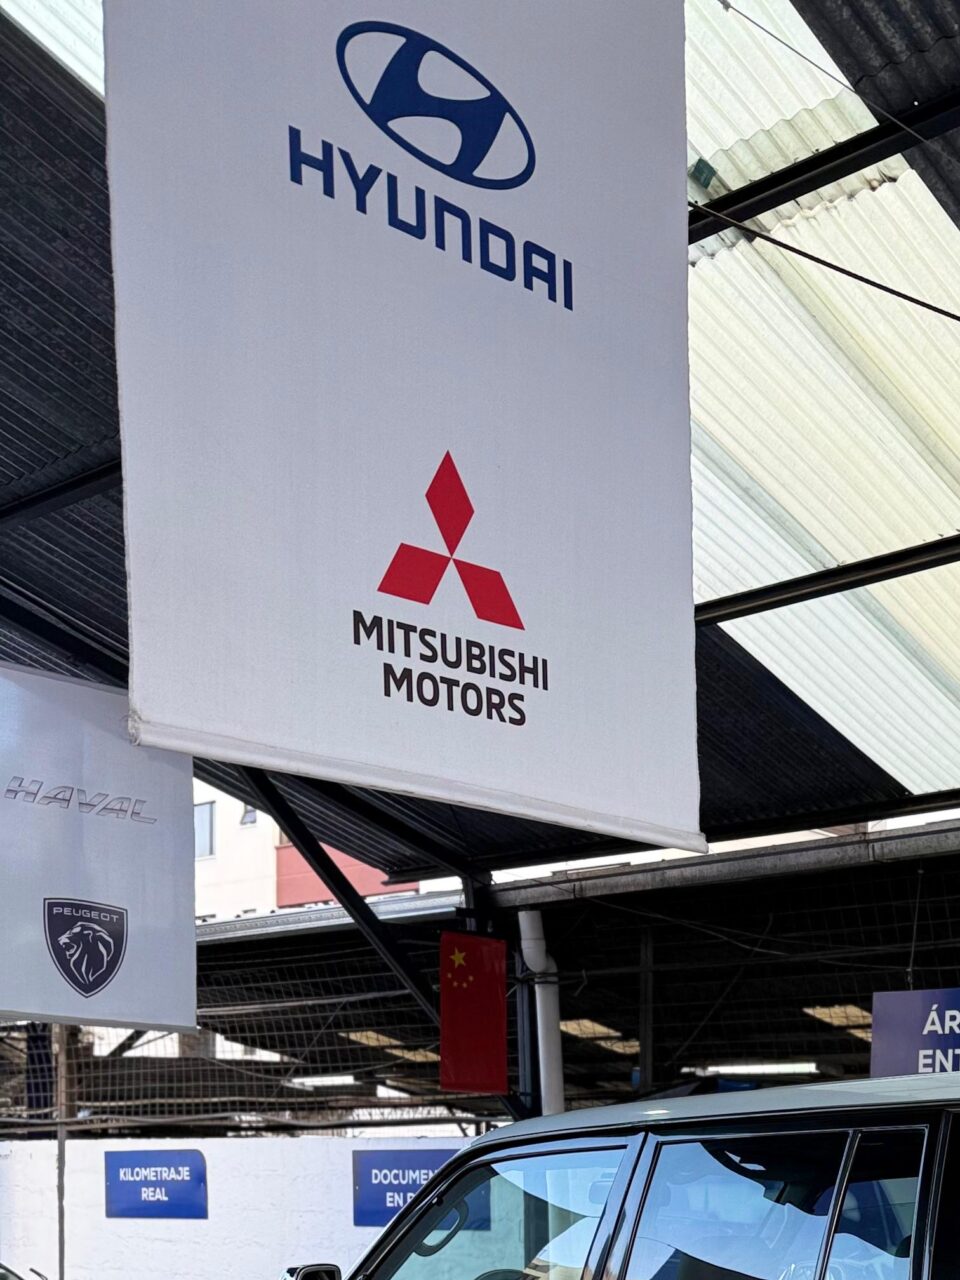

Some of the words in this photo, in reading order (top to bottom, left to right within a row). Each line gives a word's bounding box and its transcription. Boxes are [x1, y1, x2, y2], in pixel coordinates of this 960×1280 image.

[289, 125, 573, 311] HYUNDAI
[353, 610, 549, 690] MITSUBISHI
[383, 662, 526, 726] MOTORS
[4, 776, 157, 824] HAVAL
[53, 907, 119, 922] PEUGEOT
[119, 1167, 191, 1181] KILOMETRAJE
[141, 1187, 168, 1201] REAL
[386, 1192, 403, 1207] EN
